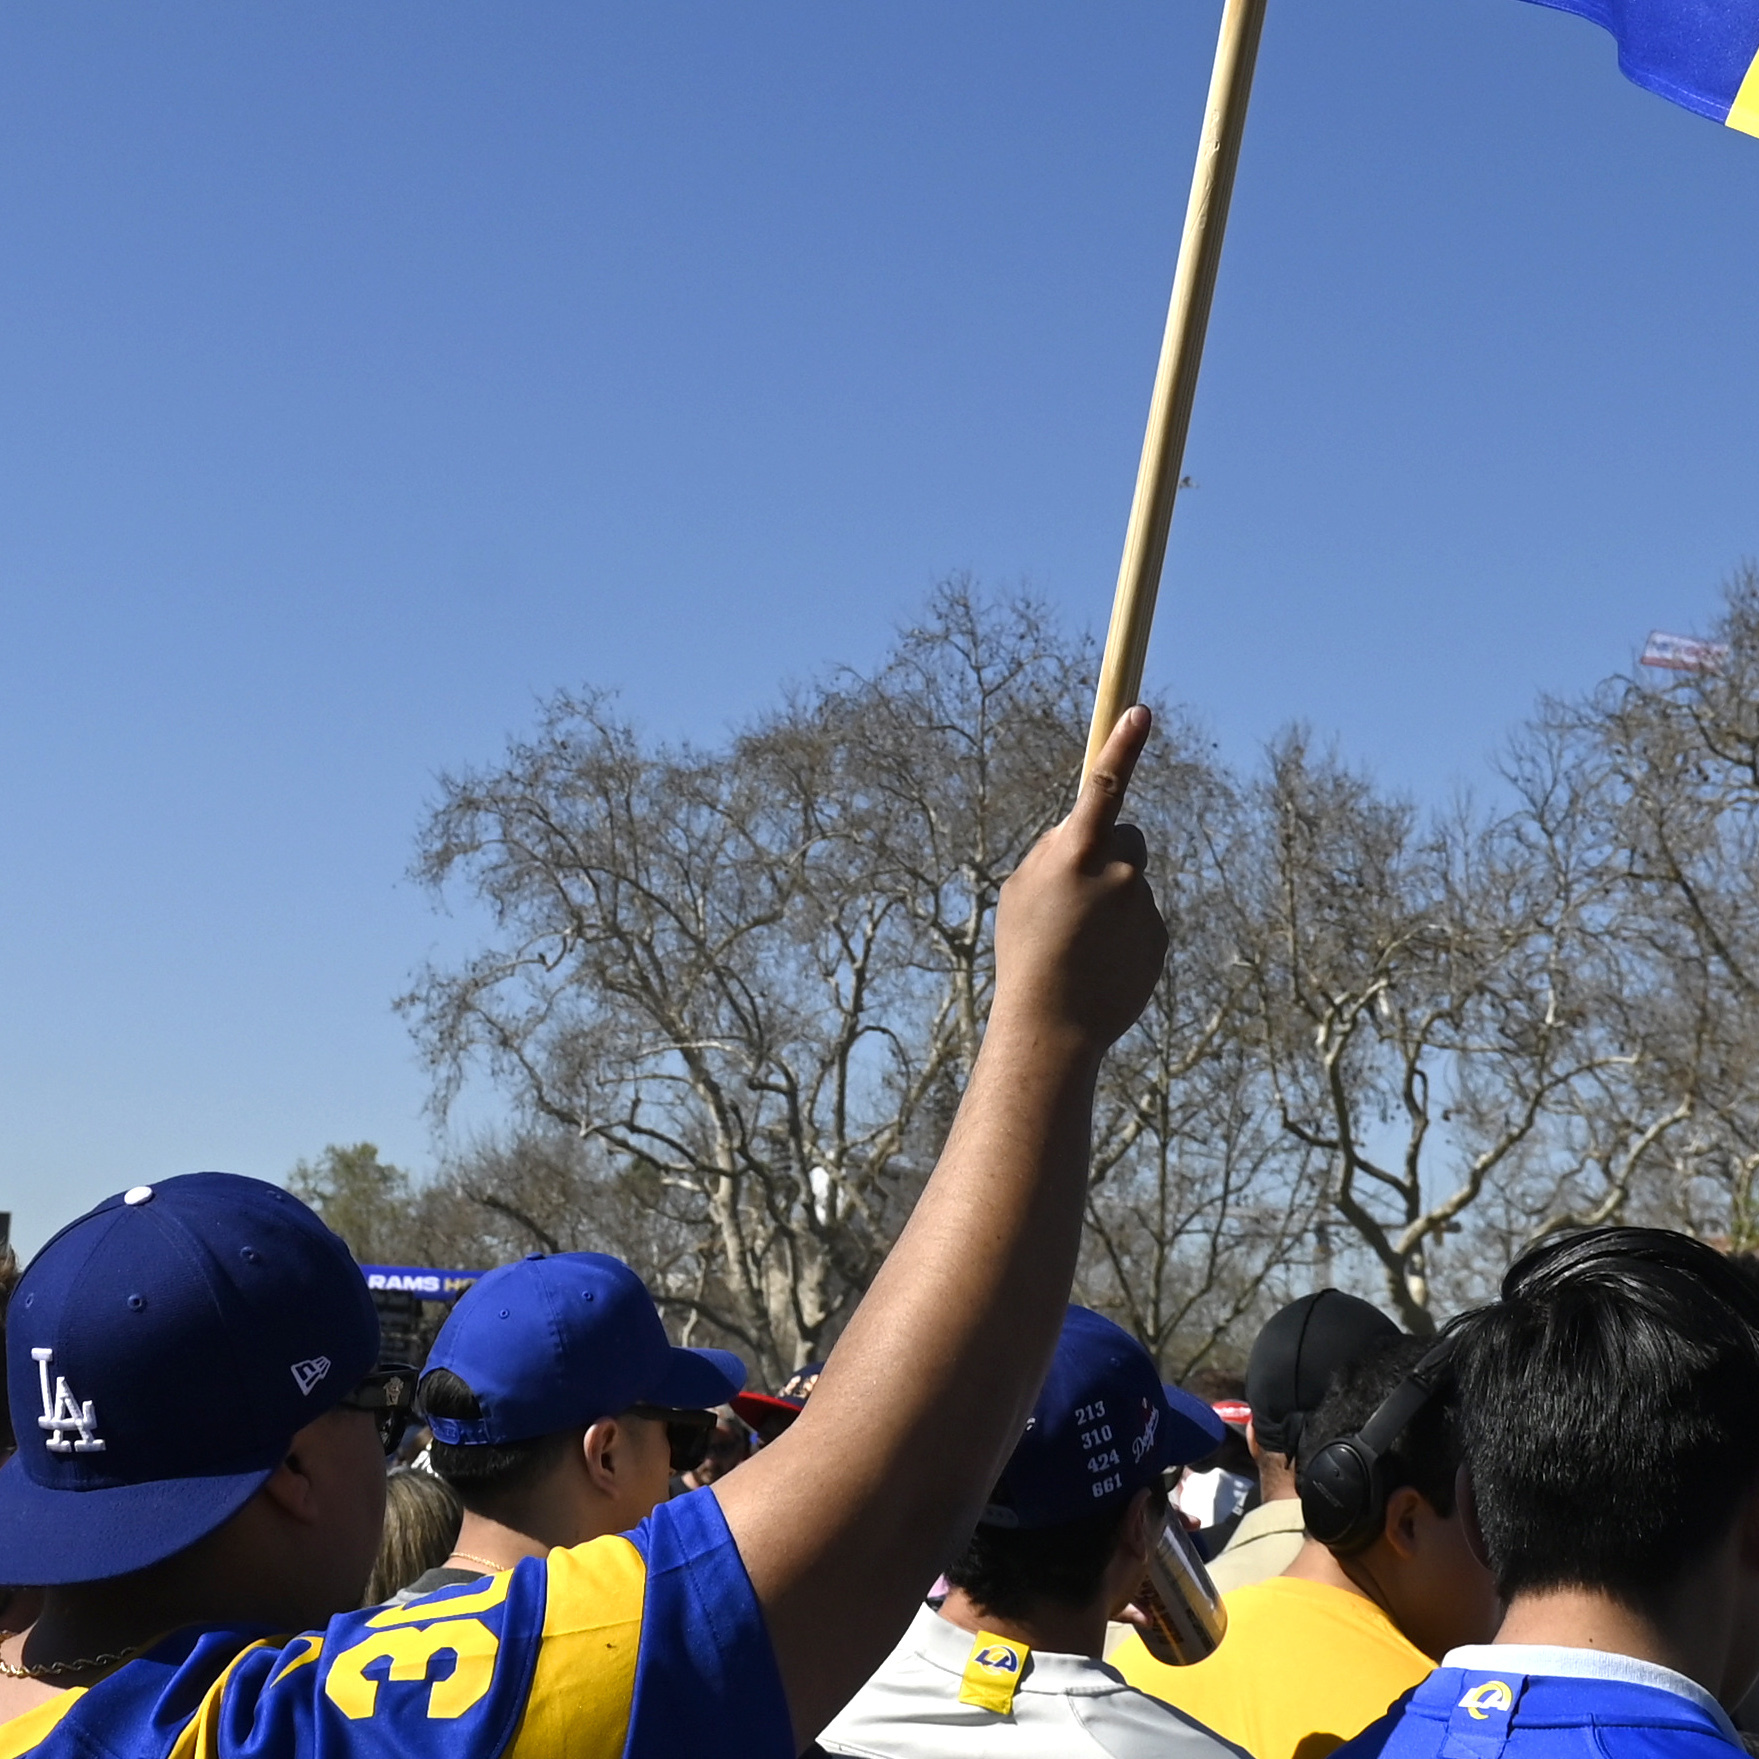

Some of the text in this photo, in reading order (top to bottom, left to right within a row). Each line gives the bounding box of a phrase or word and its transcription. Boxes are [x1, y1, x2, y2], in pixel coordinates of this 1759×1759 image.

[367, 1273, 441, 1292] RAMS
[31, 1347, 107, 1453] LA
[1074, 1400, 1106, 1426] 213
[1080, 1424, 1113, 1450] 310
[1087, 1448, 1120, 1473] 424
[1092, 1472, 1123, 1498] 661
[974, 1644, 1019, 1676] LA
[1458, 1680, 1514, 1720] LA
